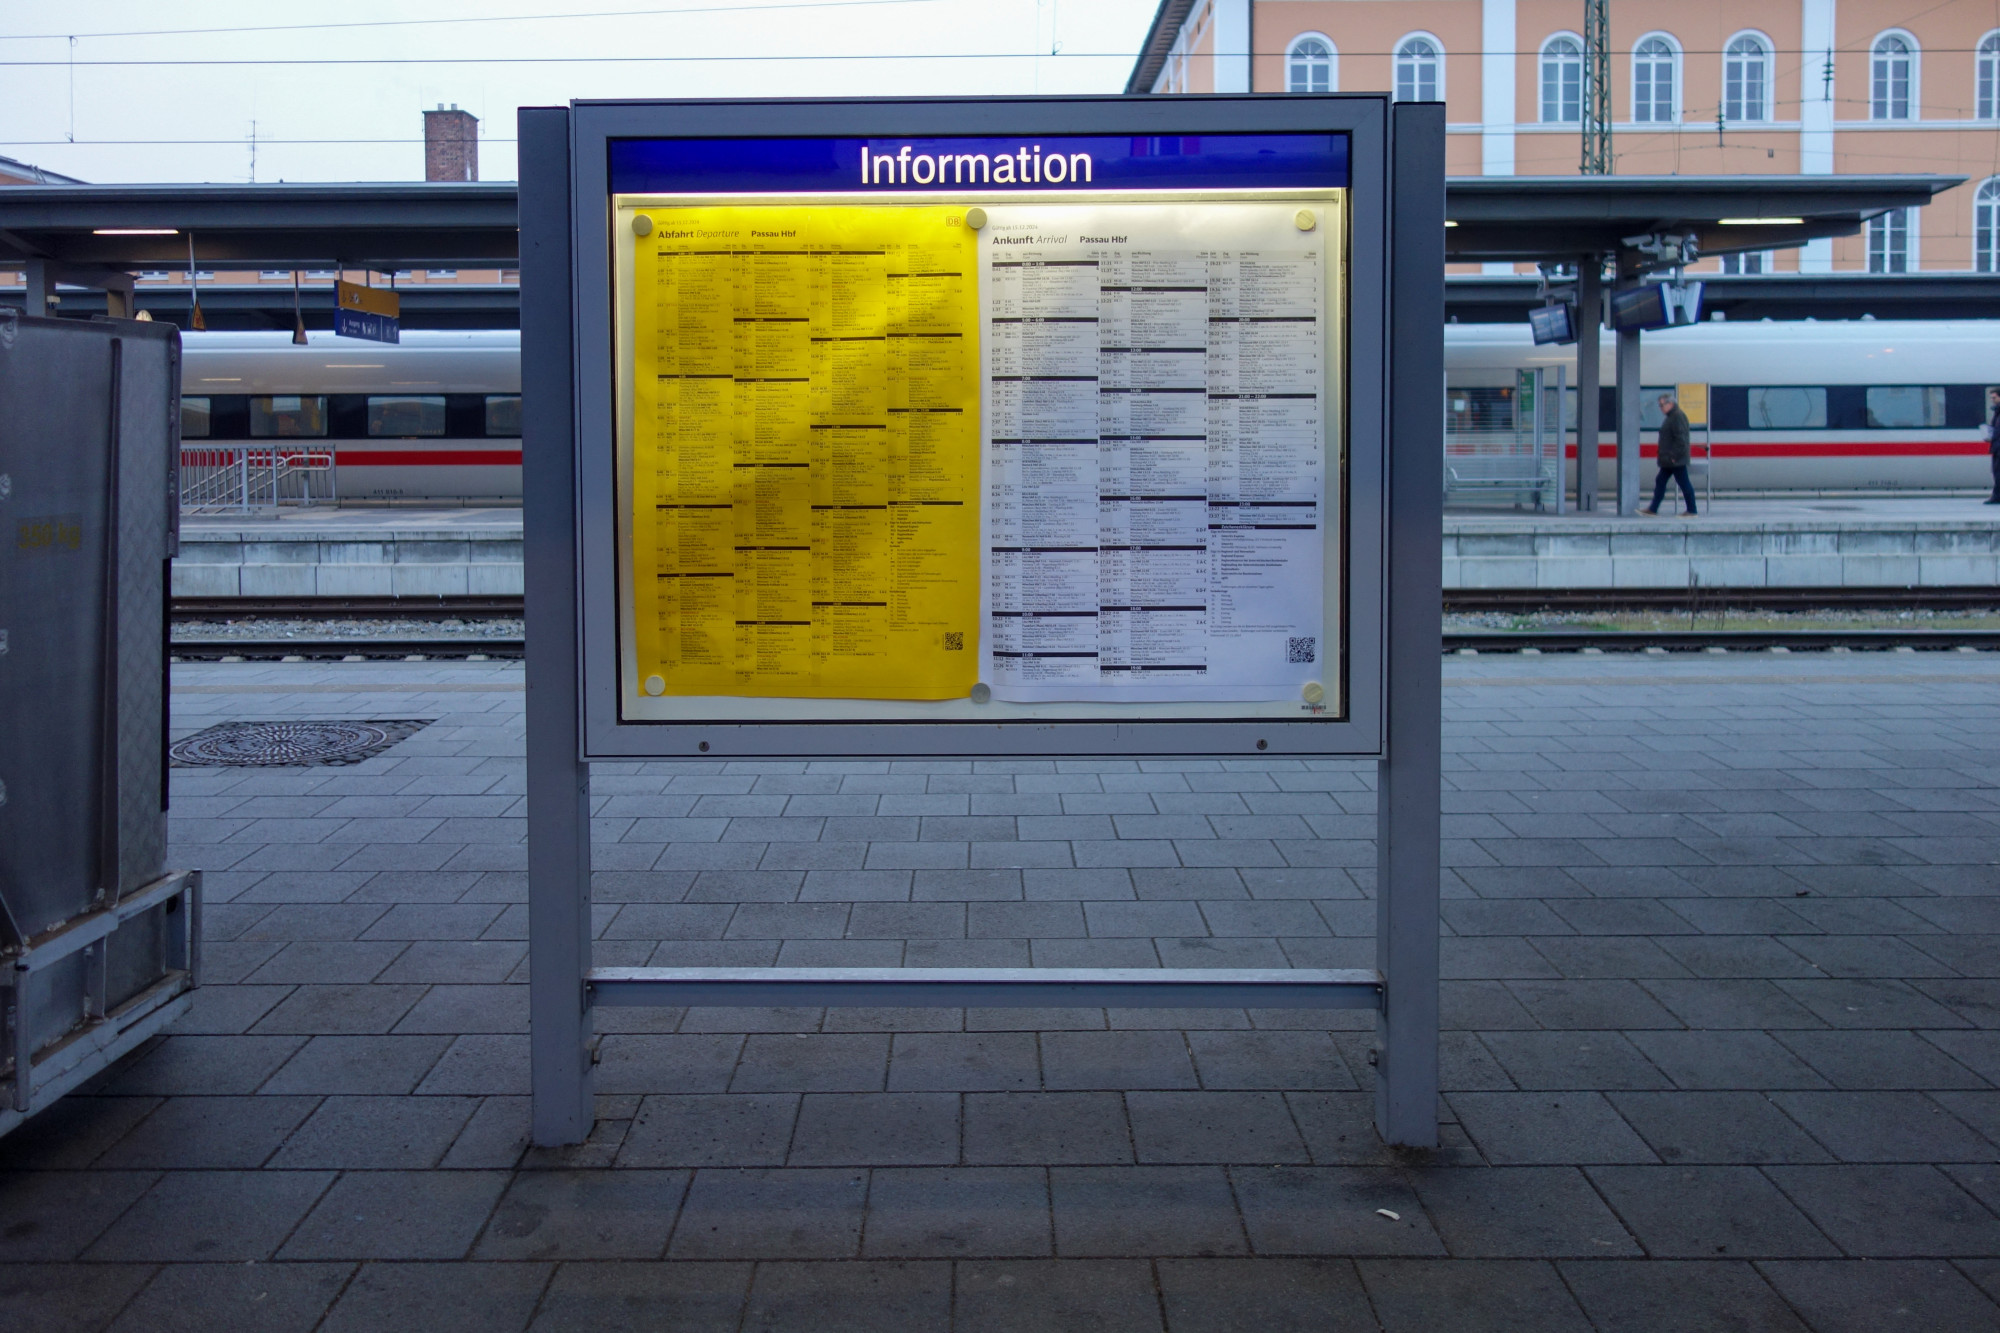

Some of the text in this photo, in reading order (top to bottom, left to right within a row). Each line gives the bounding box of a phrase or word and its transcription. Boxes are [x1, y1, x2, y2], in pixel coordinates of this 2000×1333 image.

[861, 145, 1092, 184] Information
[947, 217, 960, 226] DB
[696, 230, 740, 239] Departure
[993, 235, 1034, 244] Ankunft
[1036, 235, 1067, 244] Arrival
[19, 522, 81, 549] 350 kg
